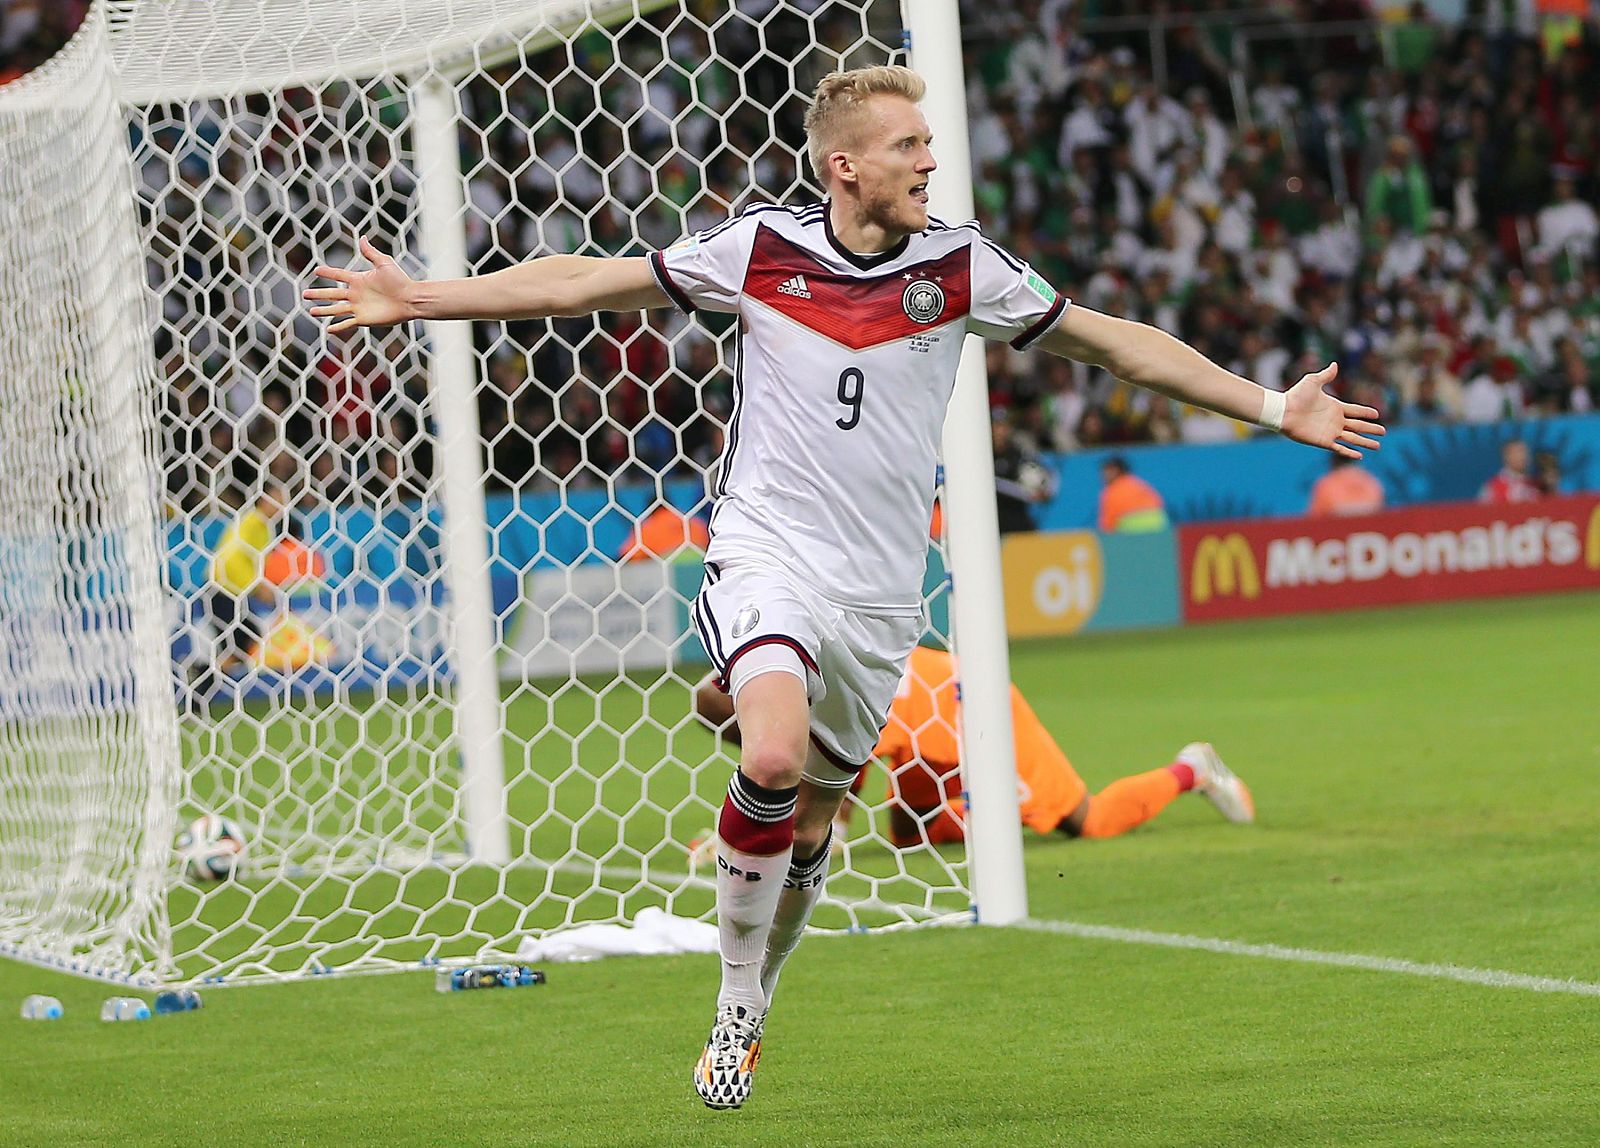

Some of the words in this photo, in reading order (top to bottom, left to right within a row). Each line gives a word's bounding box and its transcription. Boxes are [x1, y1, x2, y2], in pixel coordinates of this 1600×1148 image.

[777, 286, 812, 299] adidas
[836, 367, 864, 431] 9
[1033, 546, 1089, 616] oi
[1267, 518, 1581, 588] McDonald's
[718, 855, 762, 881] DFB
